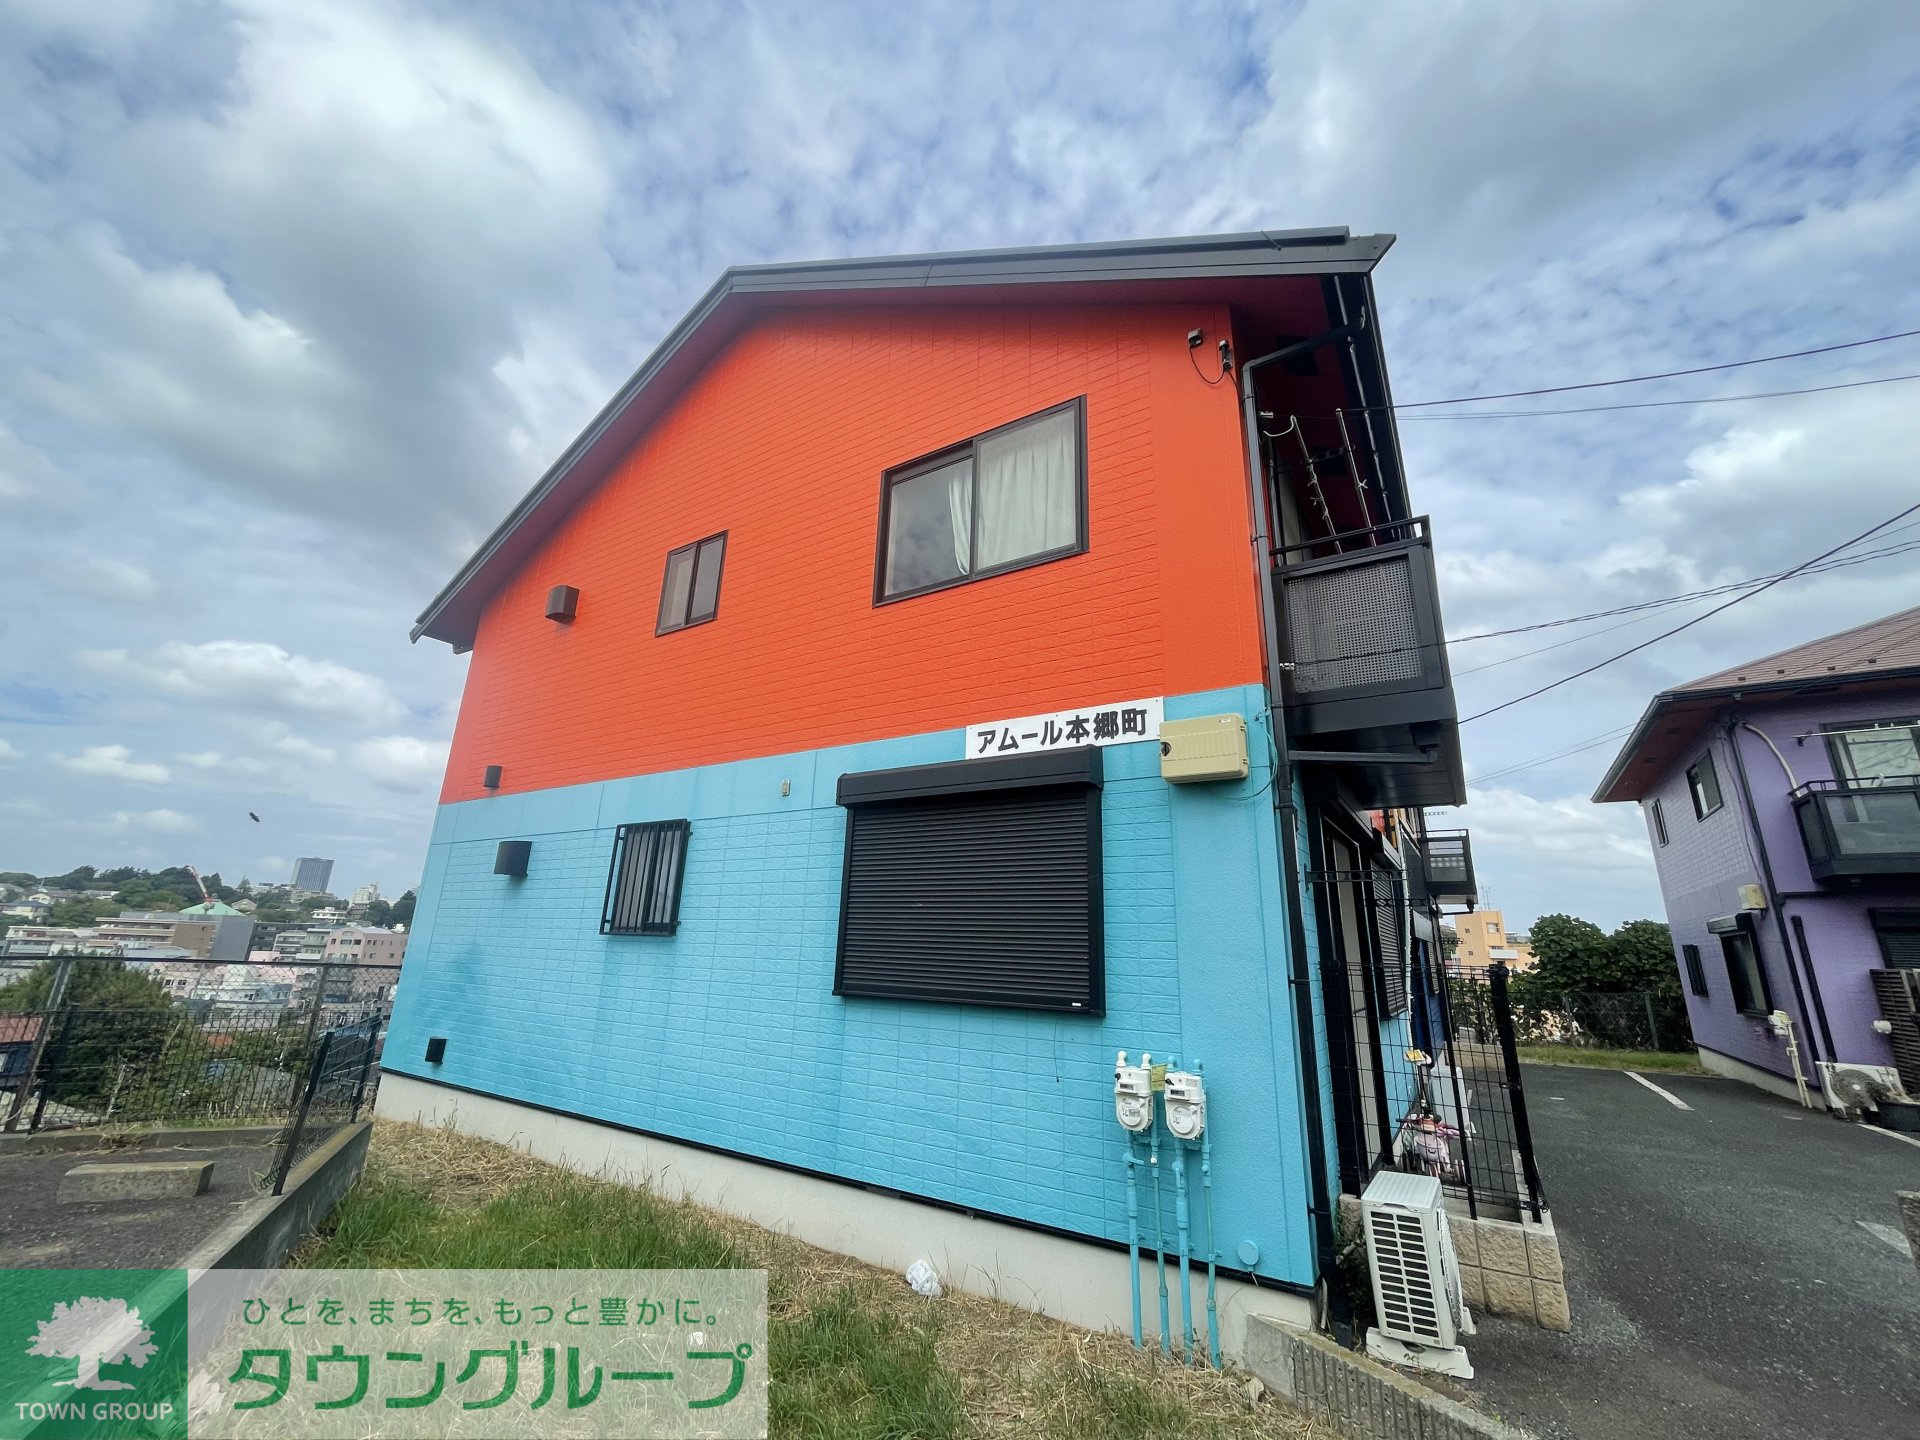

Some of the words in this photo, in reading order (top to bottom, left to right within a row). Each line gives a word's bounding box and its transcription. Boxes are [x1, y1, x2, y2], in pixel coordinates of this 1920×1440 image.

[977, 708, 1147, 754] アムール本郷町
